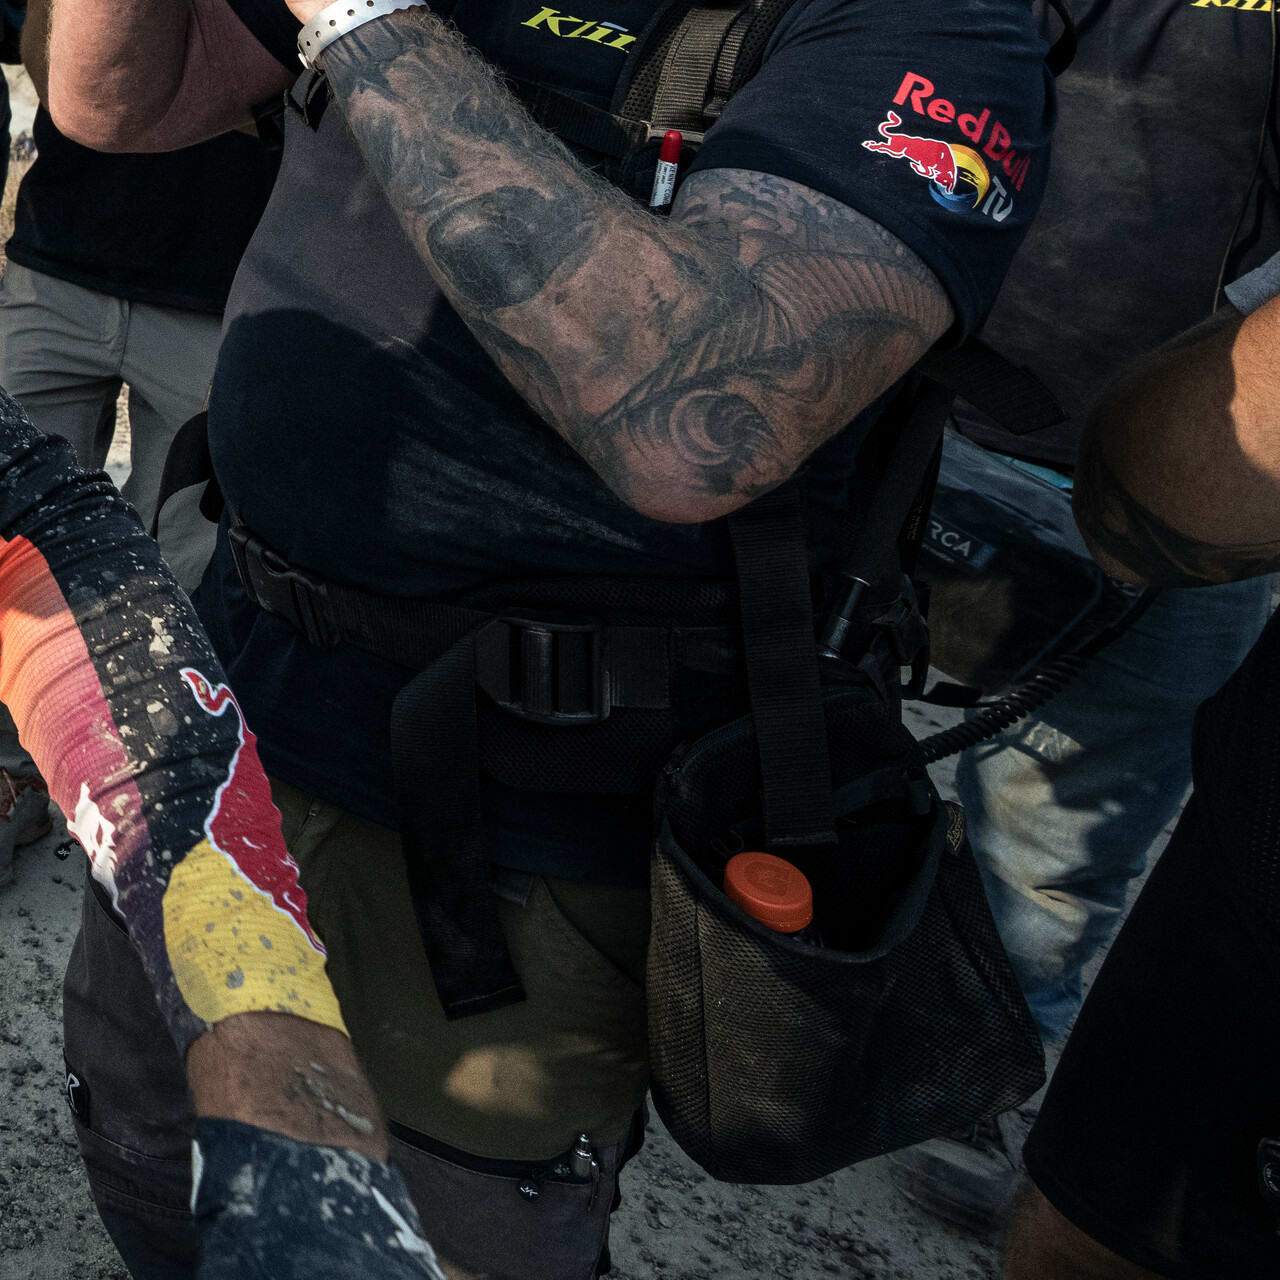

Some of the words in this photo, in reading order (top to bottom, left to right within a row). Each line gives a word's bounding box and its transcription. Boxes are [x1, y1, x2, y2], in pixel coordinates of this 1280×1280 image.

[892, 71, 991, 143] Red
[982, 120, 1032, 191] Bull
[982, 175, 1014, 222] TV
[930, 520, 971, 558] RCA
